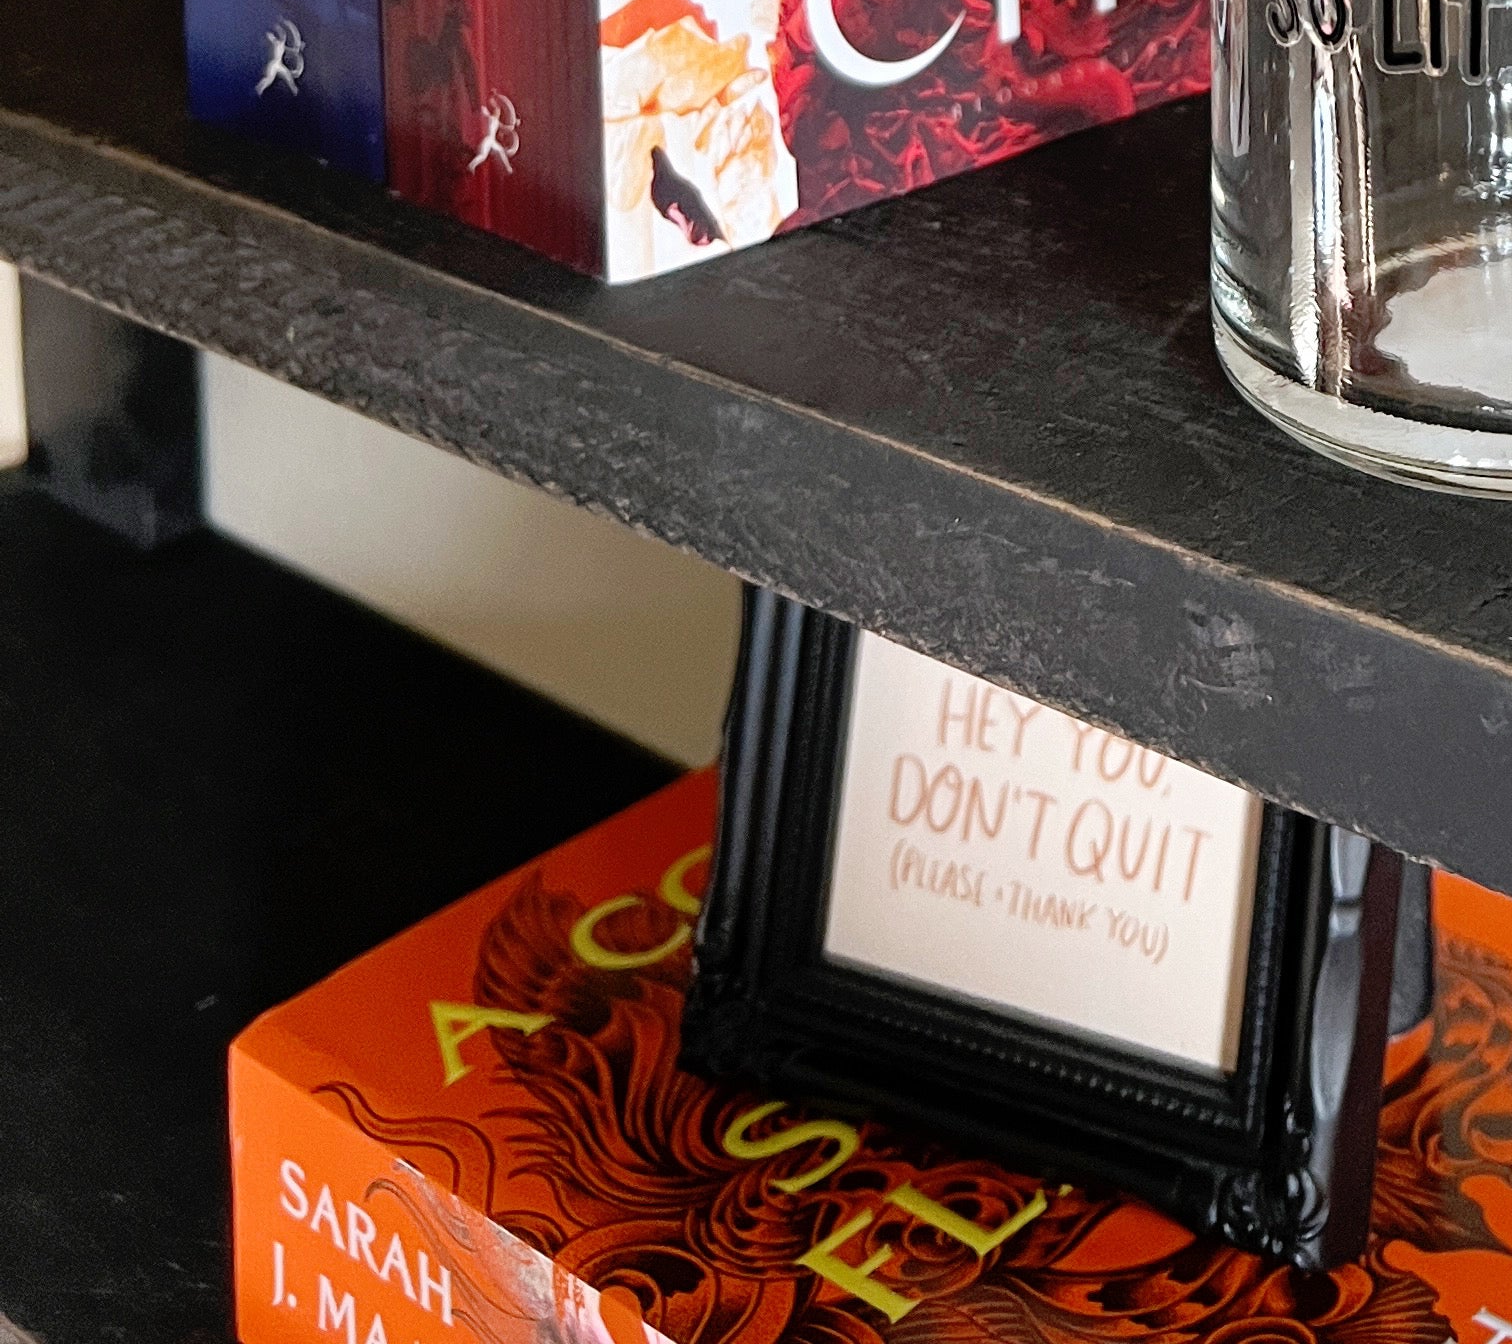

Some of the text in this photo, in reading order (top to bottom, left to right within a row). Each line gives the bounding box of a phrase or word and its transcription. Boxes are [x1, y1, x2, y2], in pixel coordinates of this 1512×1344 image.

[937, 678, 1040, 757] HEY
[890, 754, 1211, 902] DON'T QUIT
[1007, 881, 1095, 929] THANK
[272, 1241, 298, 1309] J.
[280, 1159, 454, 1327] SARAH
